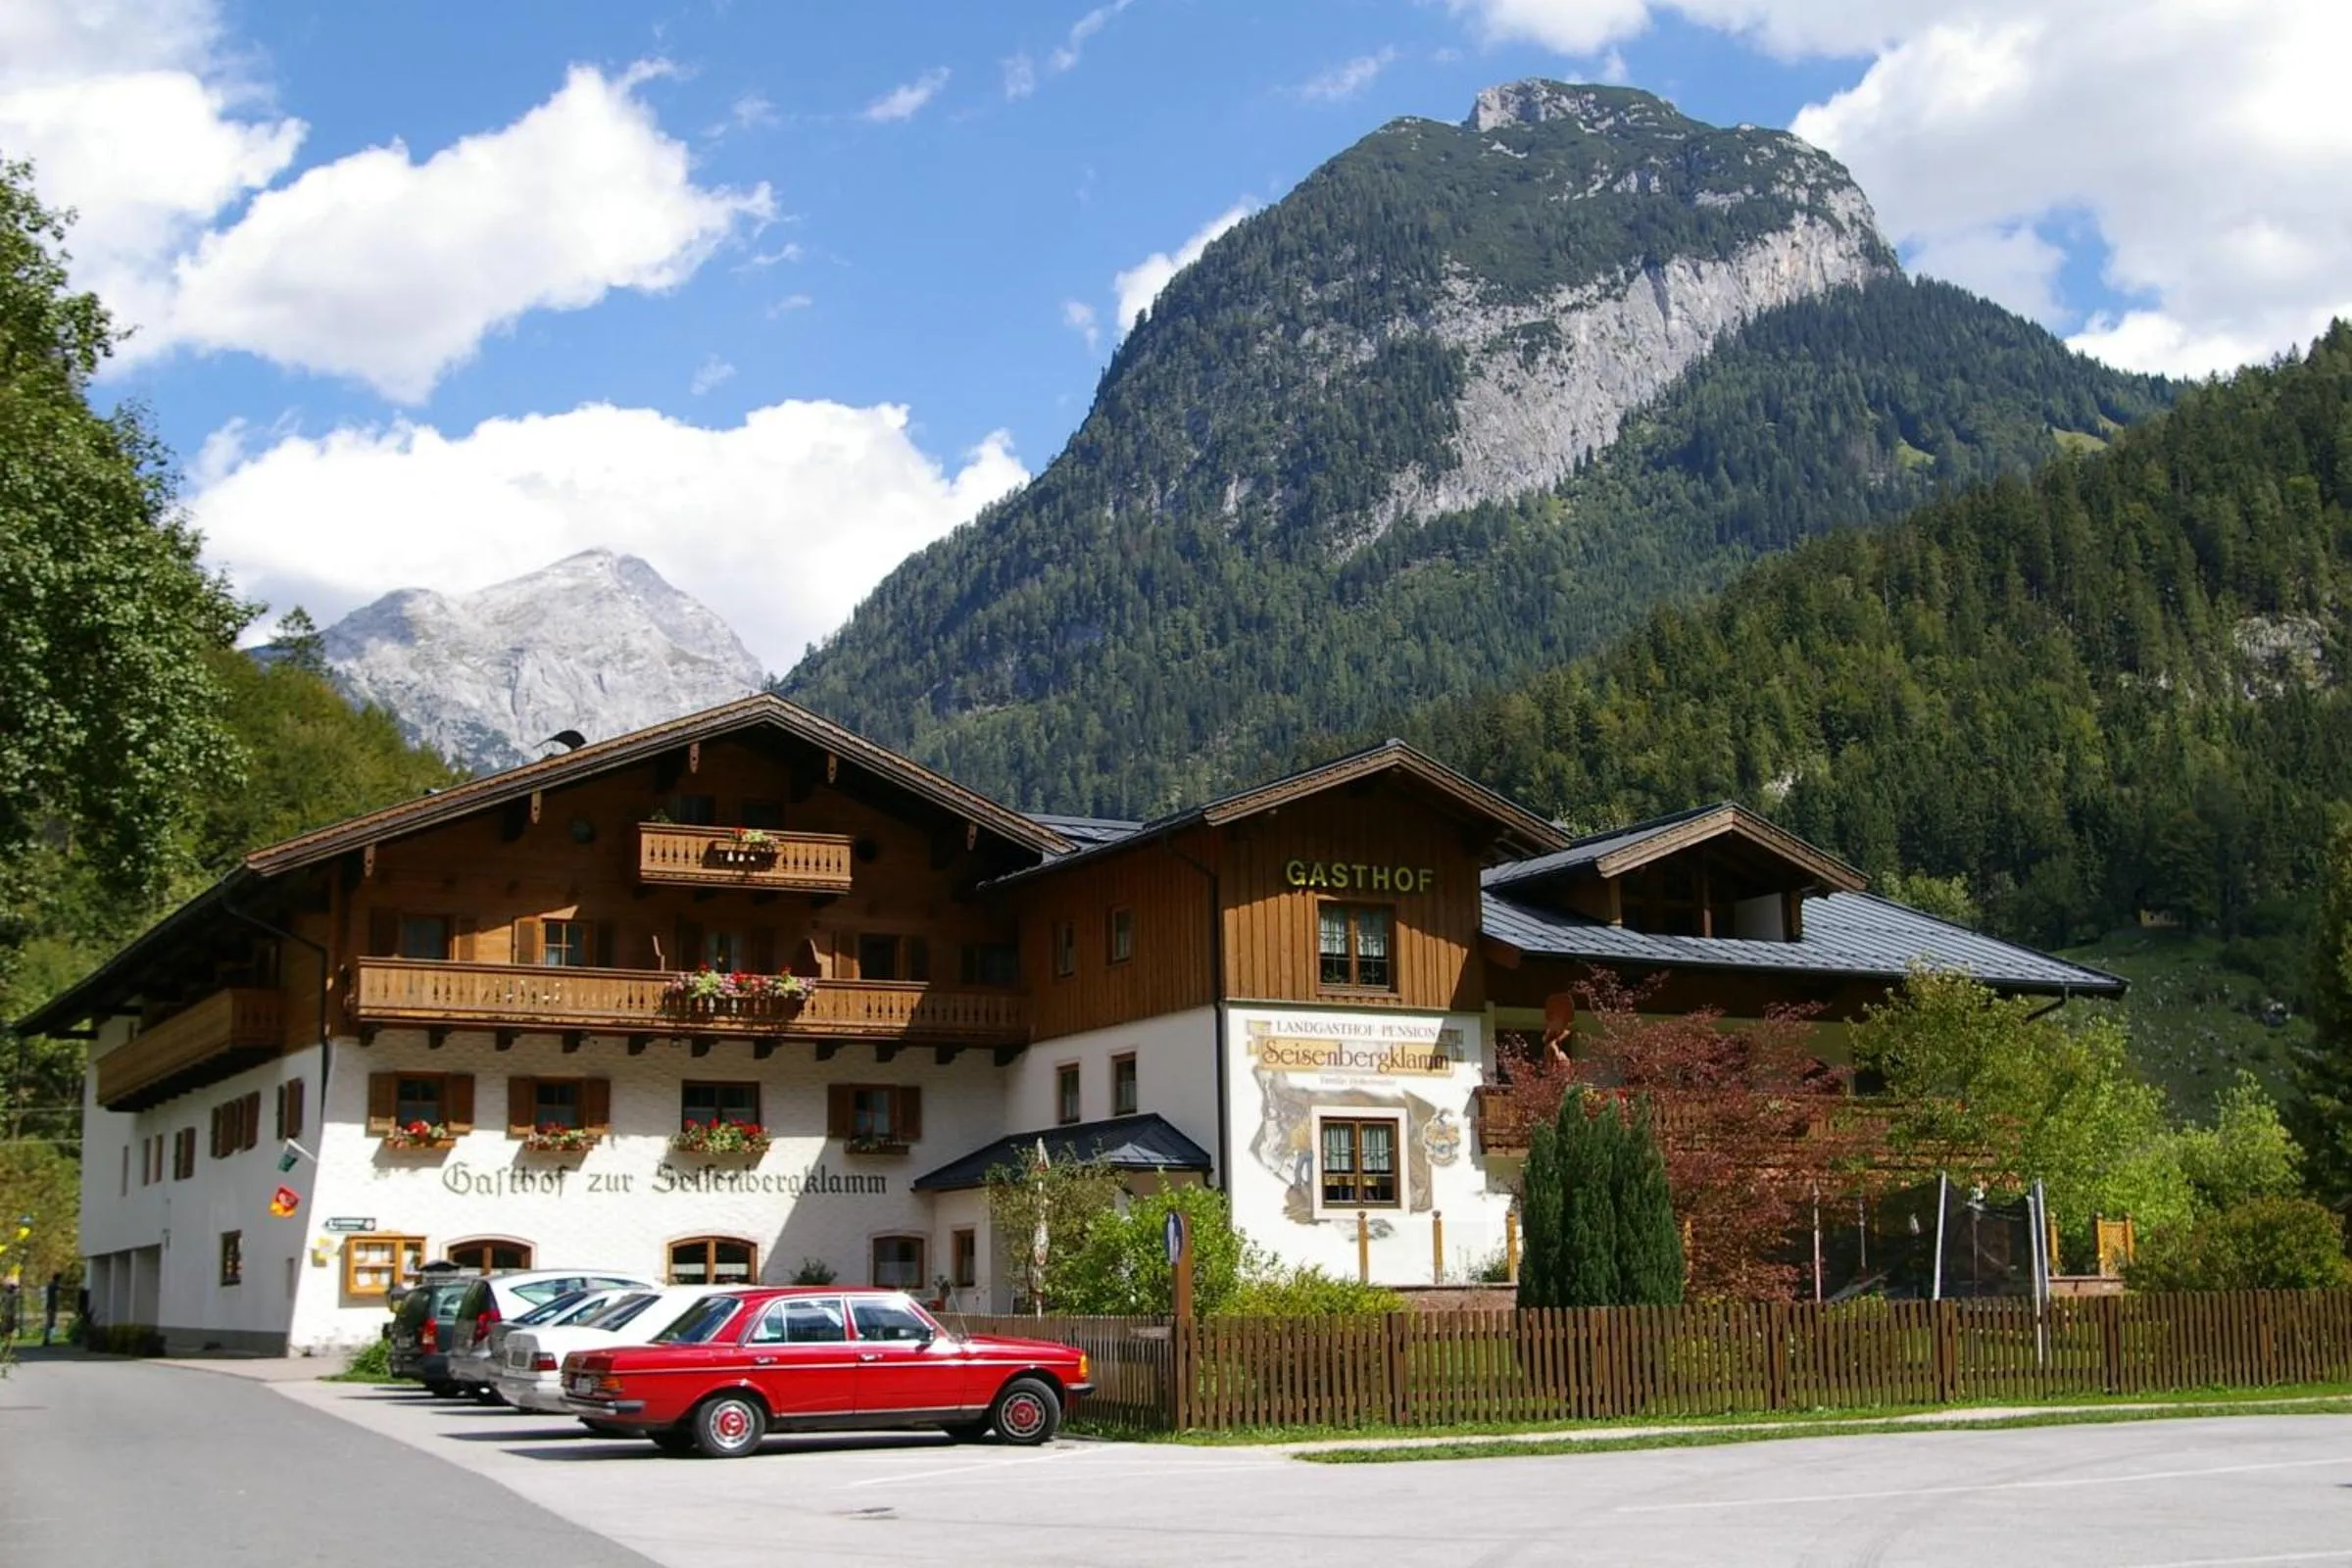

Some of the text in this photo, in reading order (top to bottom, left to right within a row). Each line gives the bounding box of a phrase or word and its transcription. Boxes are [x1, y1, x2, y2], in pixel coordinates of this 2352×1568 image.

[1286, 859, 1434, 892] GASTHOF
[1276, 1020, 1437, 1040] LANDGASTHOF PENSION
[1261, 1039, 1449, 1074] Seisenbergklamm
[442, 1161, 568, 1198] Gasthof
[587, 1172, 634, 1193] zur
